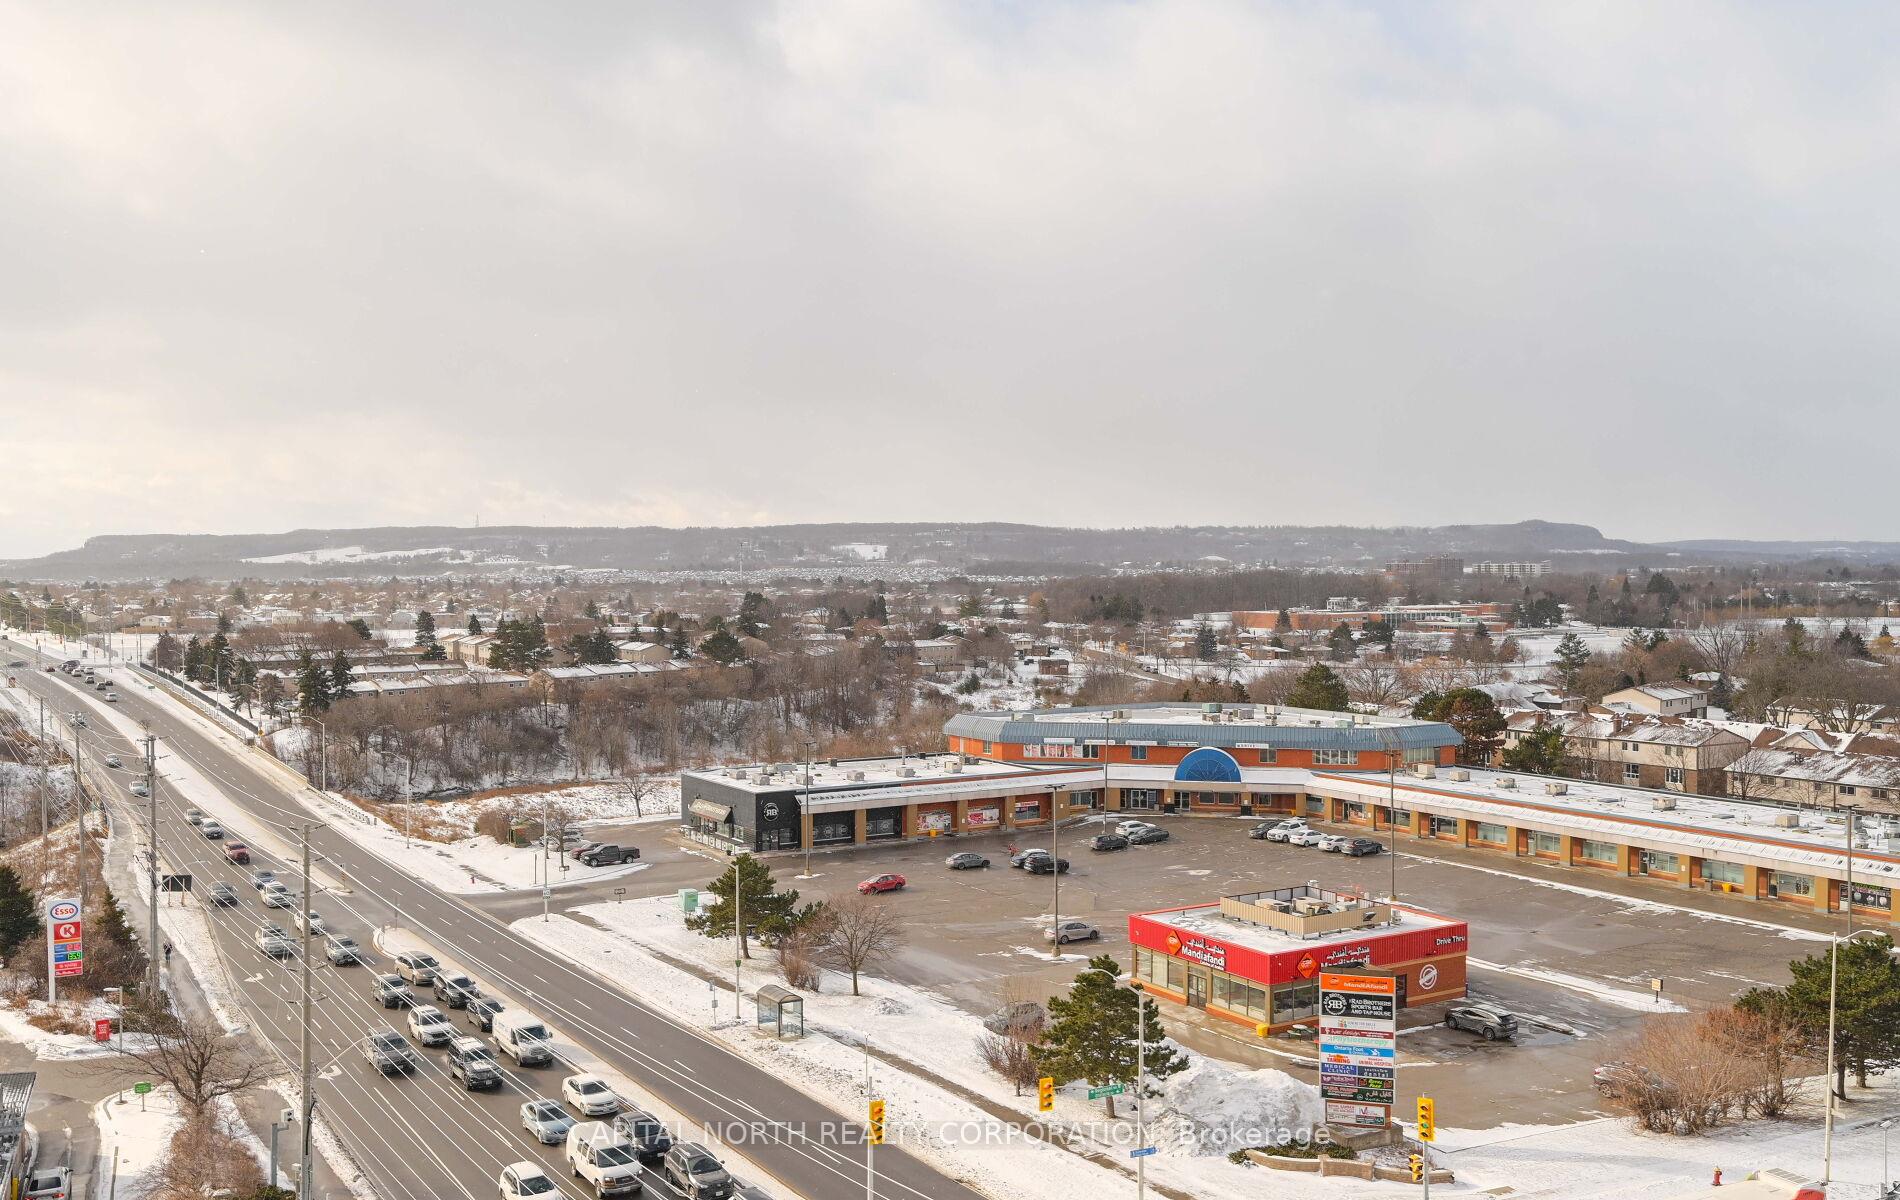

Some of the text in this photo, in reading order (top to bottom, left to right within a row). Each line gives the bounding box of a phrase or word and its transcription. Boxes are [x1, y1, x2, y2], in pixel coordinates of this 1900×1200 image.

[54, 907, 75, 916] Esso
[1436, 935, 1466, 946] Drive Thru
[1324, 1063, 1355, 1071] MEDICAL
